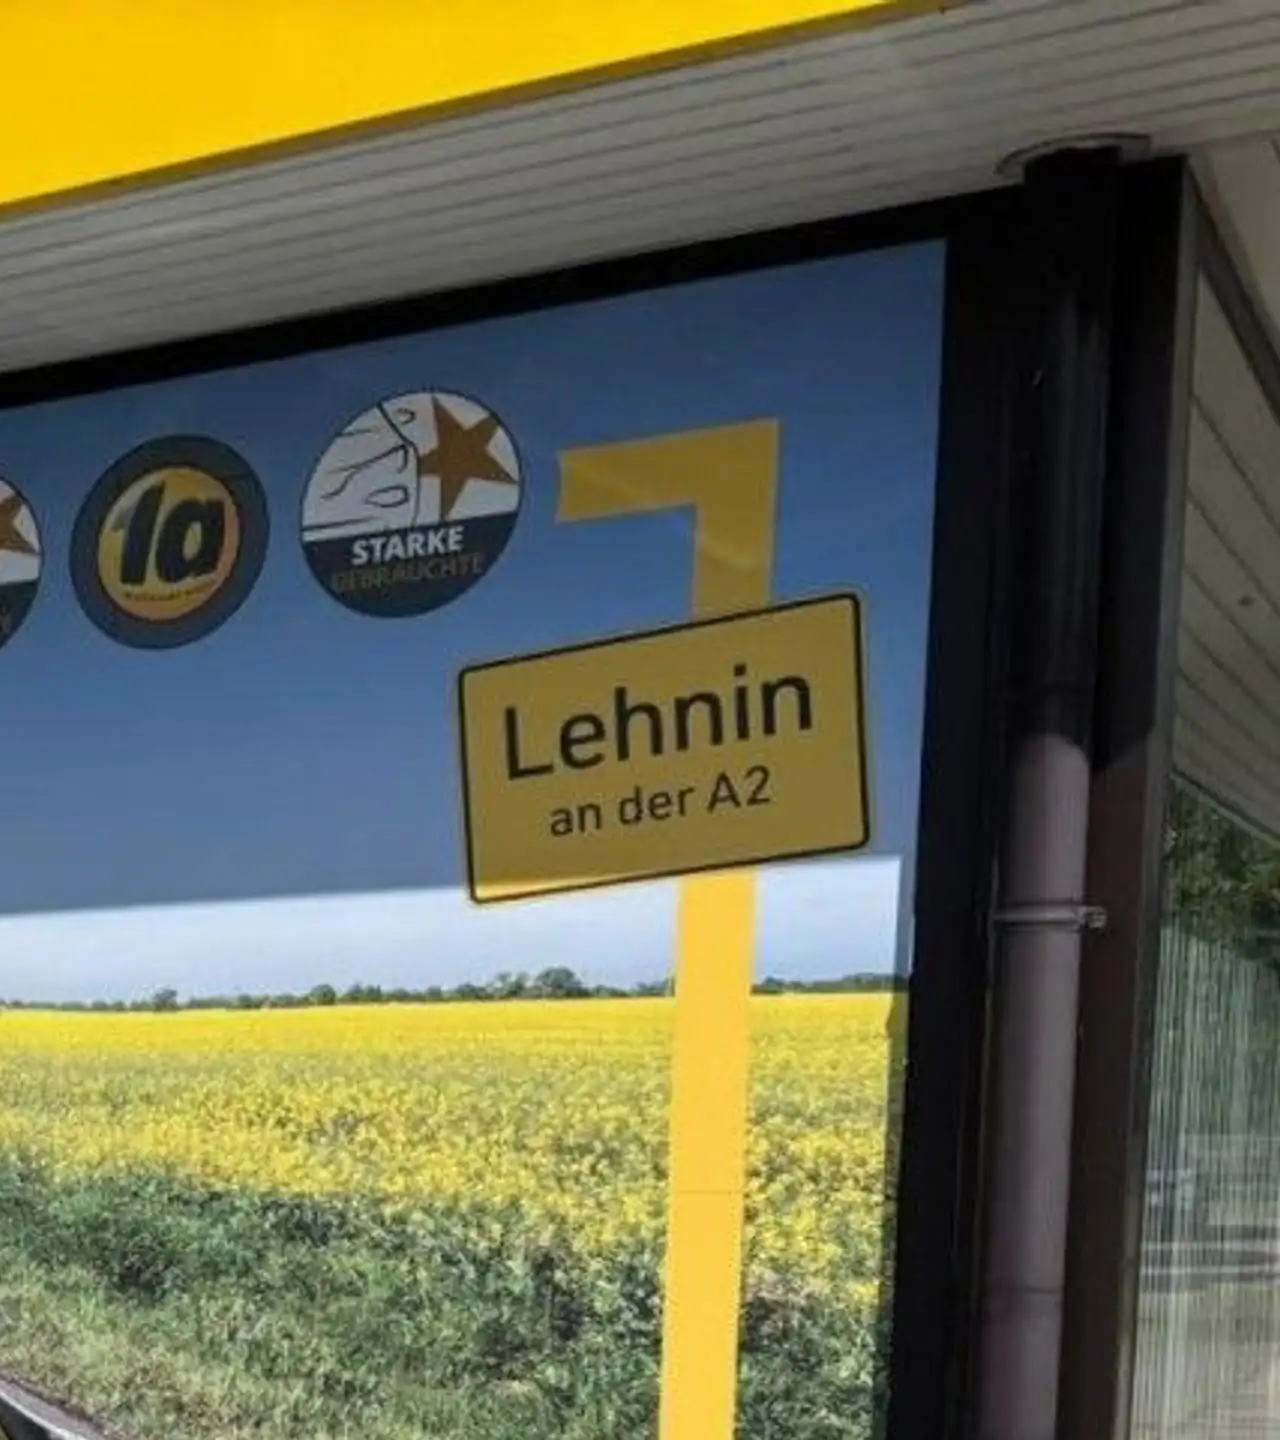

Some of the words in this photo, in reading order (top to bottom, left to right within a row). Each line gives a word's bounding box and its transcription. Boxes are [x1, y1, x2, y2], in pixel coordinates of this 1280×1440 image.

[112, 479, 226, 586] 1a
[351, 525, 465, 567] STARKE
[504, 662, 814, 781] Lehnin
[550, 800, 603, 838] an
[618, 786, 696, 825] der
[706, 764, 772, 813] A2
